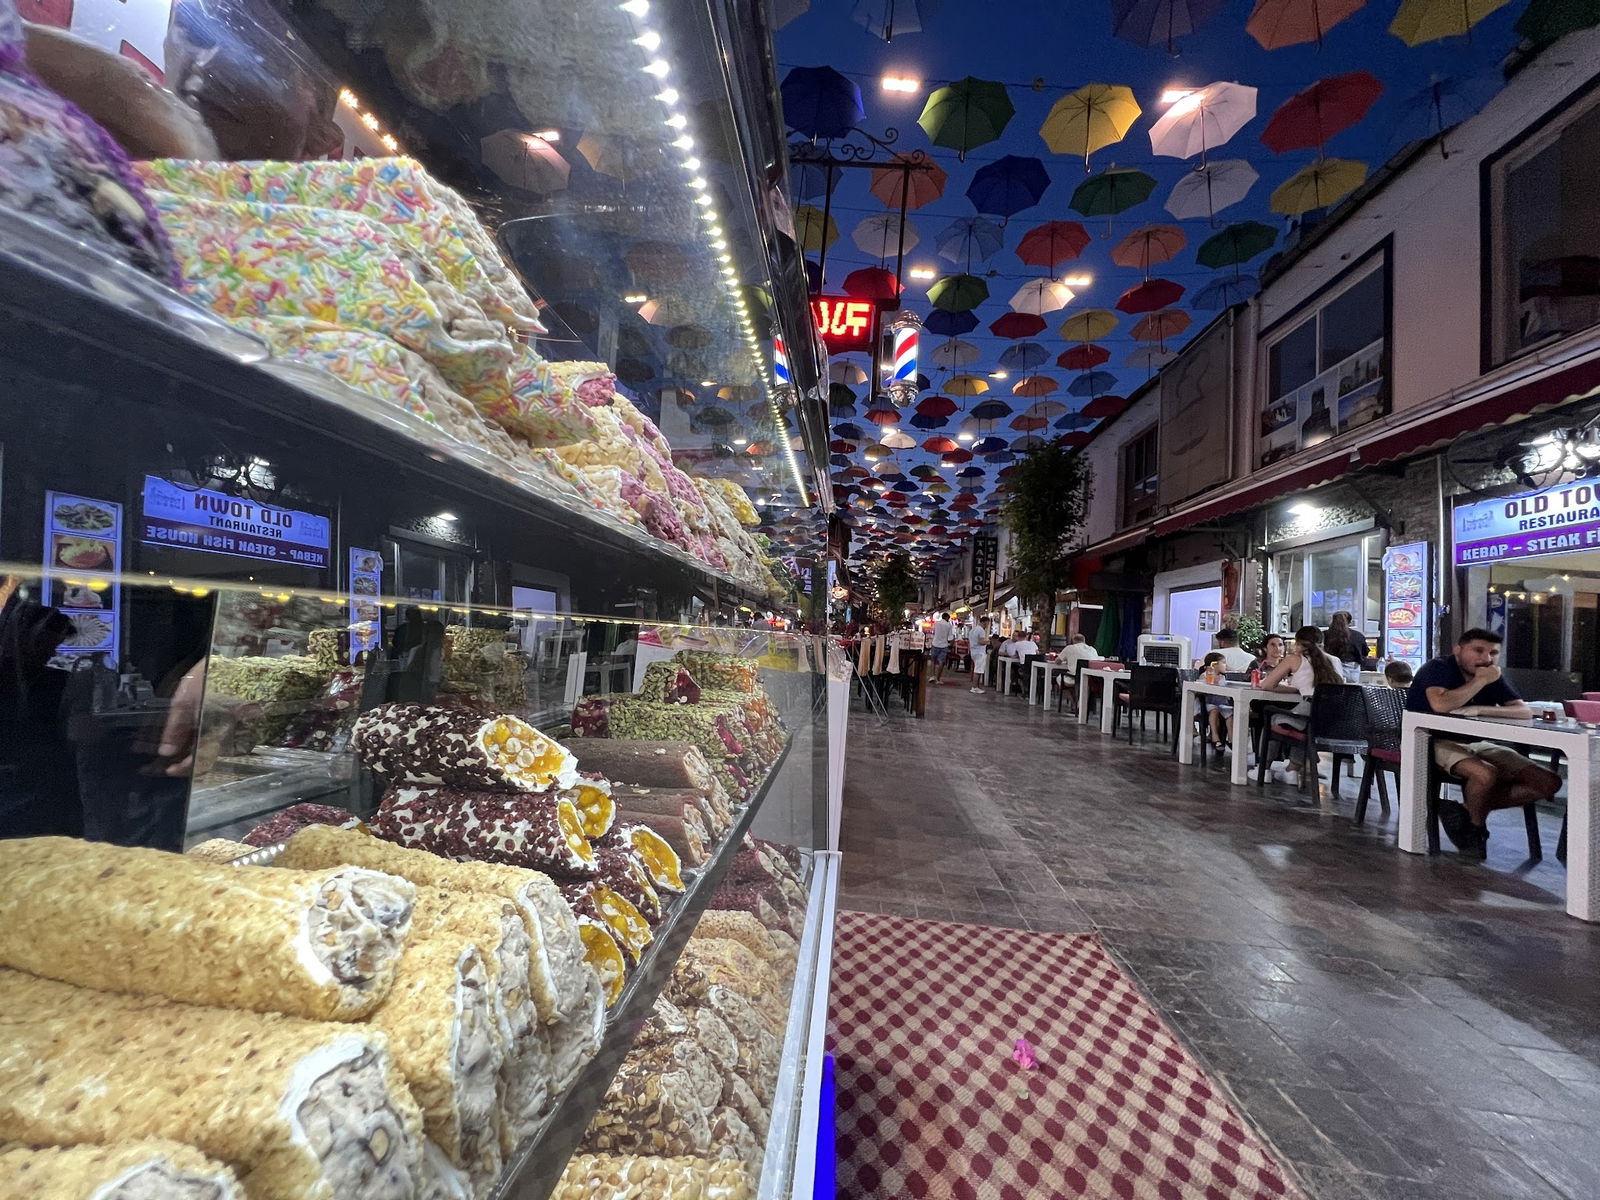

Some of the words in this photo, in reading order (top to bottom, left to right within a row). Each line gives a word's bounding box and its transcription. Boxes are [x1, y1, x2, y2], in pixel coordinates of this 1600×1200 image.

[1504, 495, 1549, 519] OLD
[1519, 506, 1600, 531] RESTAURA
[1462, 544, 1508, 560] KEBAP
[1527, 532, 1580, 552] STEAK
[974, 540, 985, 591] TATTOO
